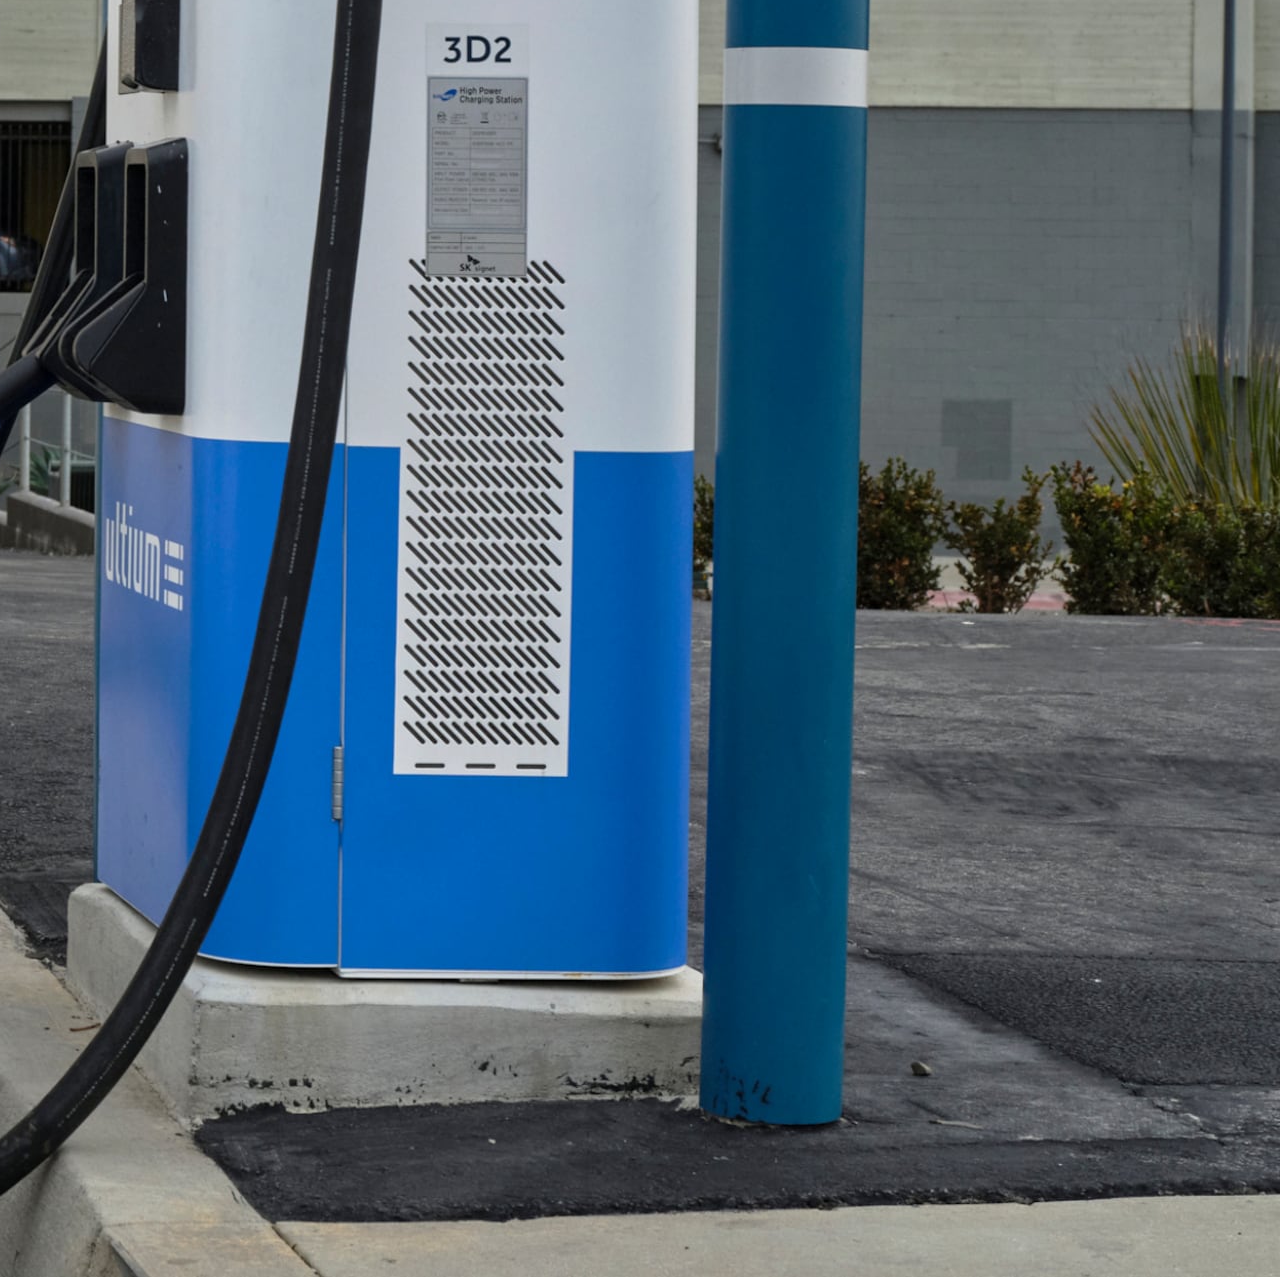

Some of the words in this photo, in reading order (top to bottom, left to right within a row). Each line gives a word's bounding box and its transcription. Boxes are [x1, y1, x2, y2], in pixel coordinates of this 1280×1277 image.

[444, 36, 511, 63] 3D2
[460, 87, 477, 96] High
[479, 87, 502, 95] Power
[460, 96, 493, 105] Charging
[496, 96, 523, 105] Station
[459, 264, 471, 272] SK
[105, 501, 160, 601] ultium
